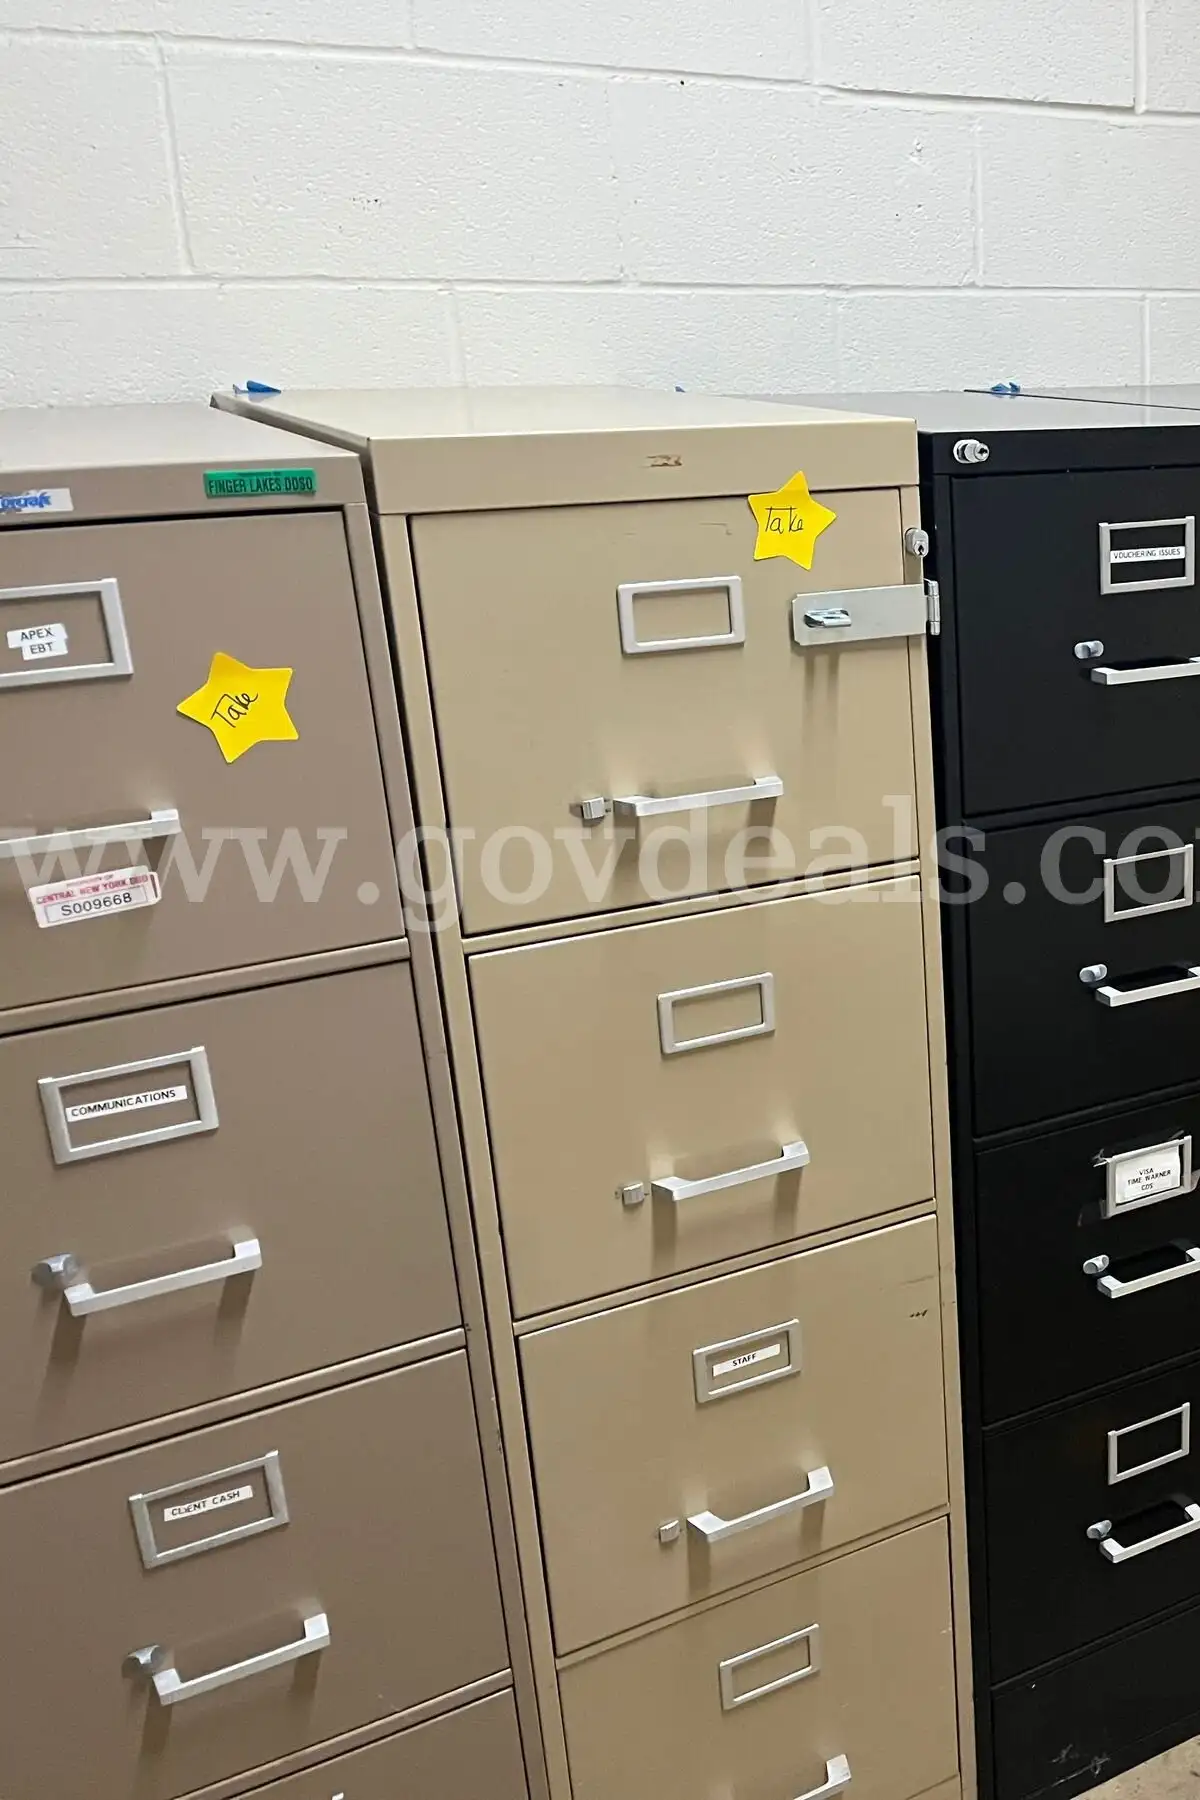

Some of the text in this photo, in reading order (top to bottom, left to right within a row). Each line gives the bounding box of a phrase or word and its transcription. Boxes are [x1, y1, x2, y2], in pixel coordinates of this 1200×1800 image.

[208, 479, 247, 494] FINGER
[250, 477, 281, 492] LAKES
[764, 507, 804, 533] Take
[1113, 548, 1181, 559] VOUCHERING ISSUES
[20, 627, 54, 642] APEX
[30, 642, 53, 655] EBT
[211, 692, 258, 729] Take
[80, 885, 100, 895] NEW
[103, 879, 127, 891] YORK
[61, 892, 132, 916] S009668
[71, 1089, 176, 1117] COMMUNICATIONS
[1127, 1170, 1170, 1185] TIME WARNER
[732, 1353, 756, 1366] STAFF
[171, 1490, 240, 1516] CLIENT CASH
